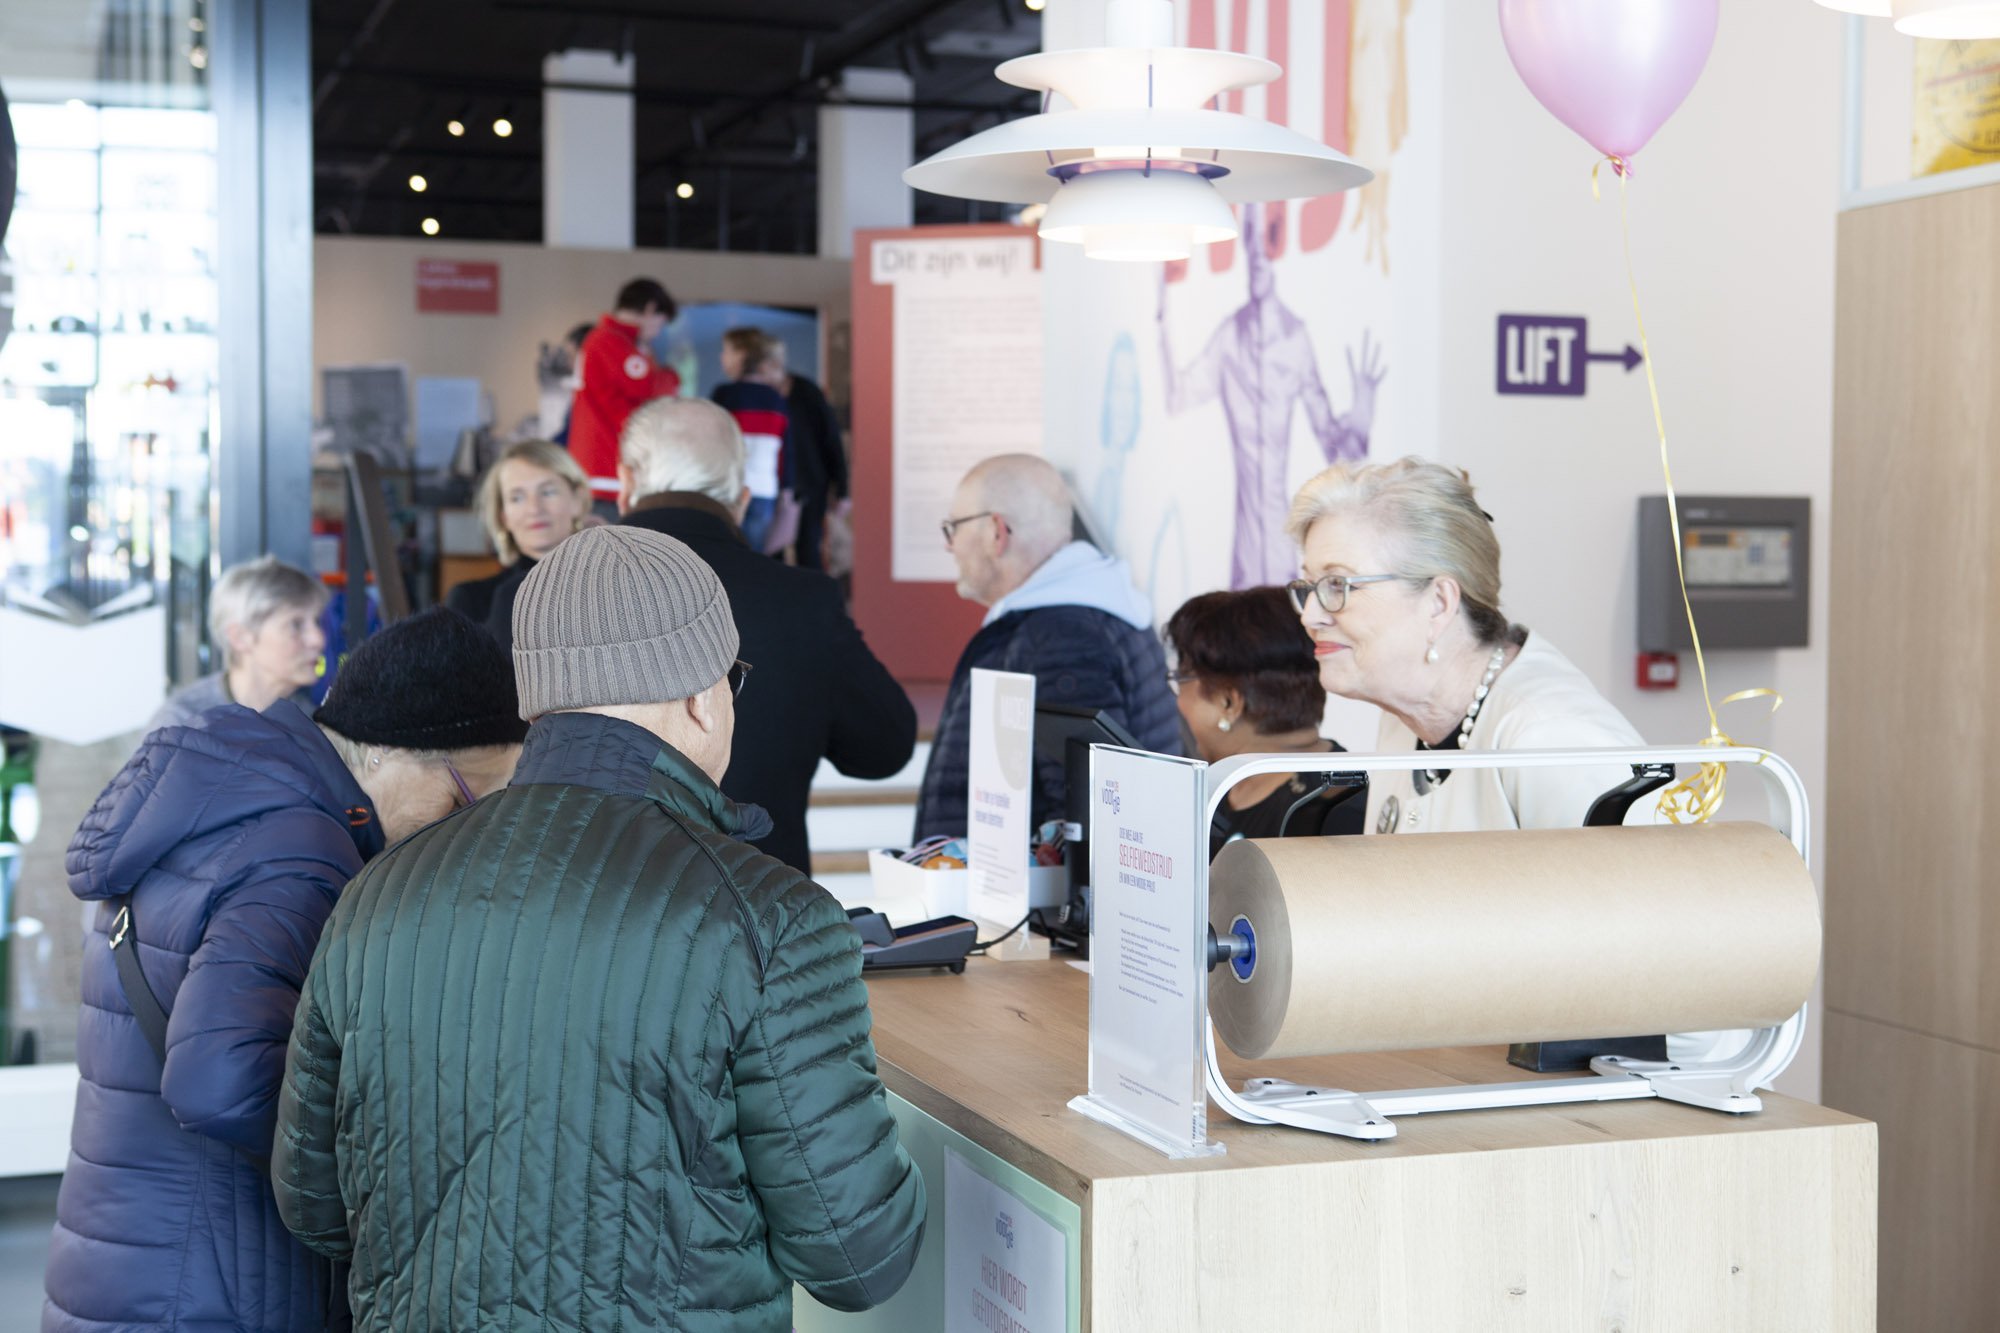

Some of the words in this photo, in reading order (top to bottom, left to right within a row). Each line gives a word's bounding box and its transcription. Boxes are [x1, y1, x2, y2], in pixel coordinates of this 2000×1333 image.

[880, 246, 916, 272] Dit
[1506, 325, 1577, 385] LIFT
[1119, 844, 1173, 879] SELFIEWEDSTRIJD
[981, 1253, 998, 1293] HIER
[999, 1266, 1028, 1315] WORDT
